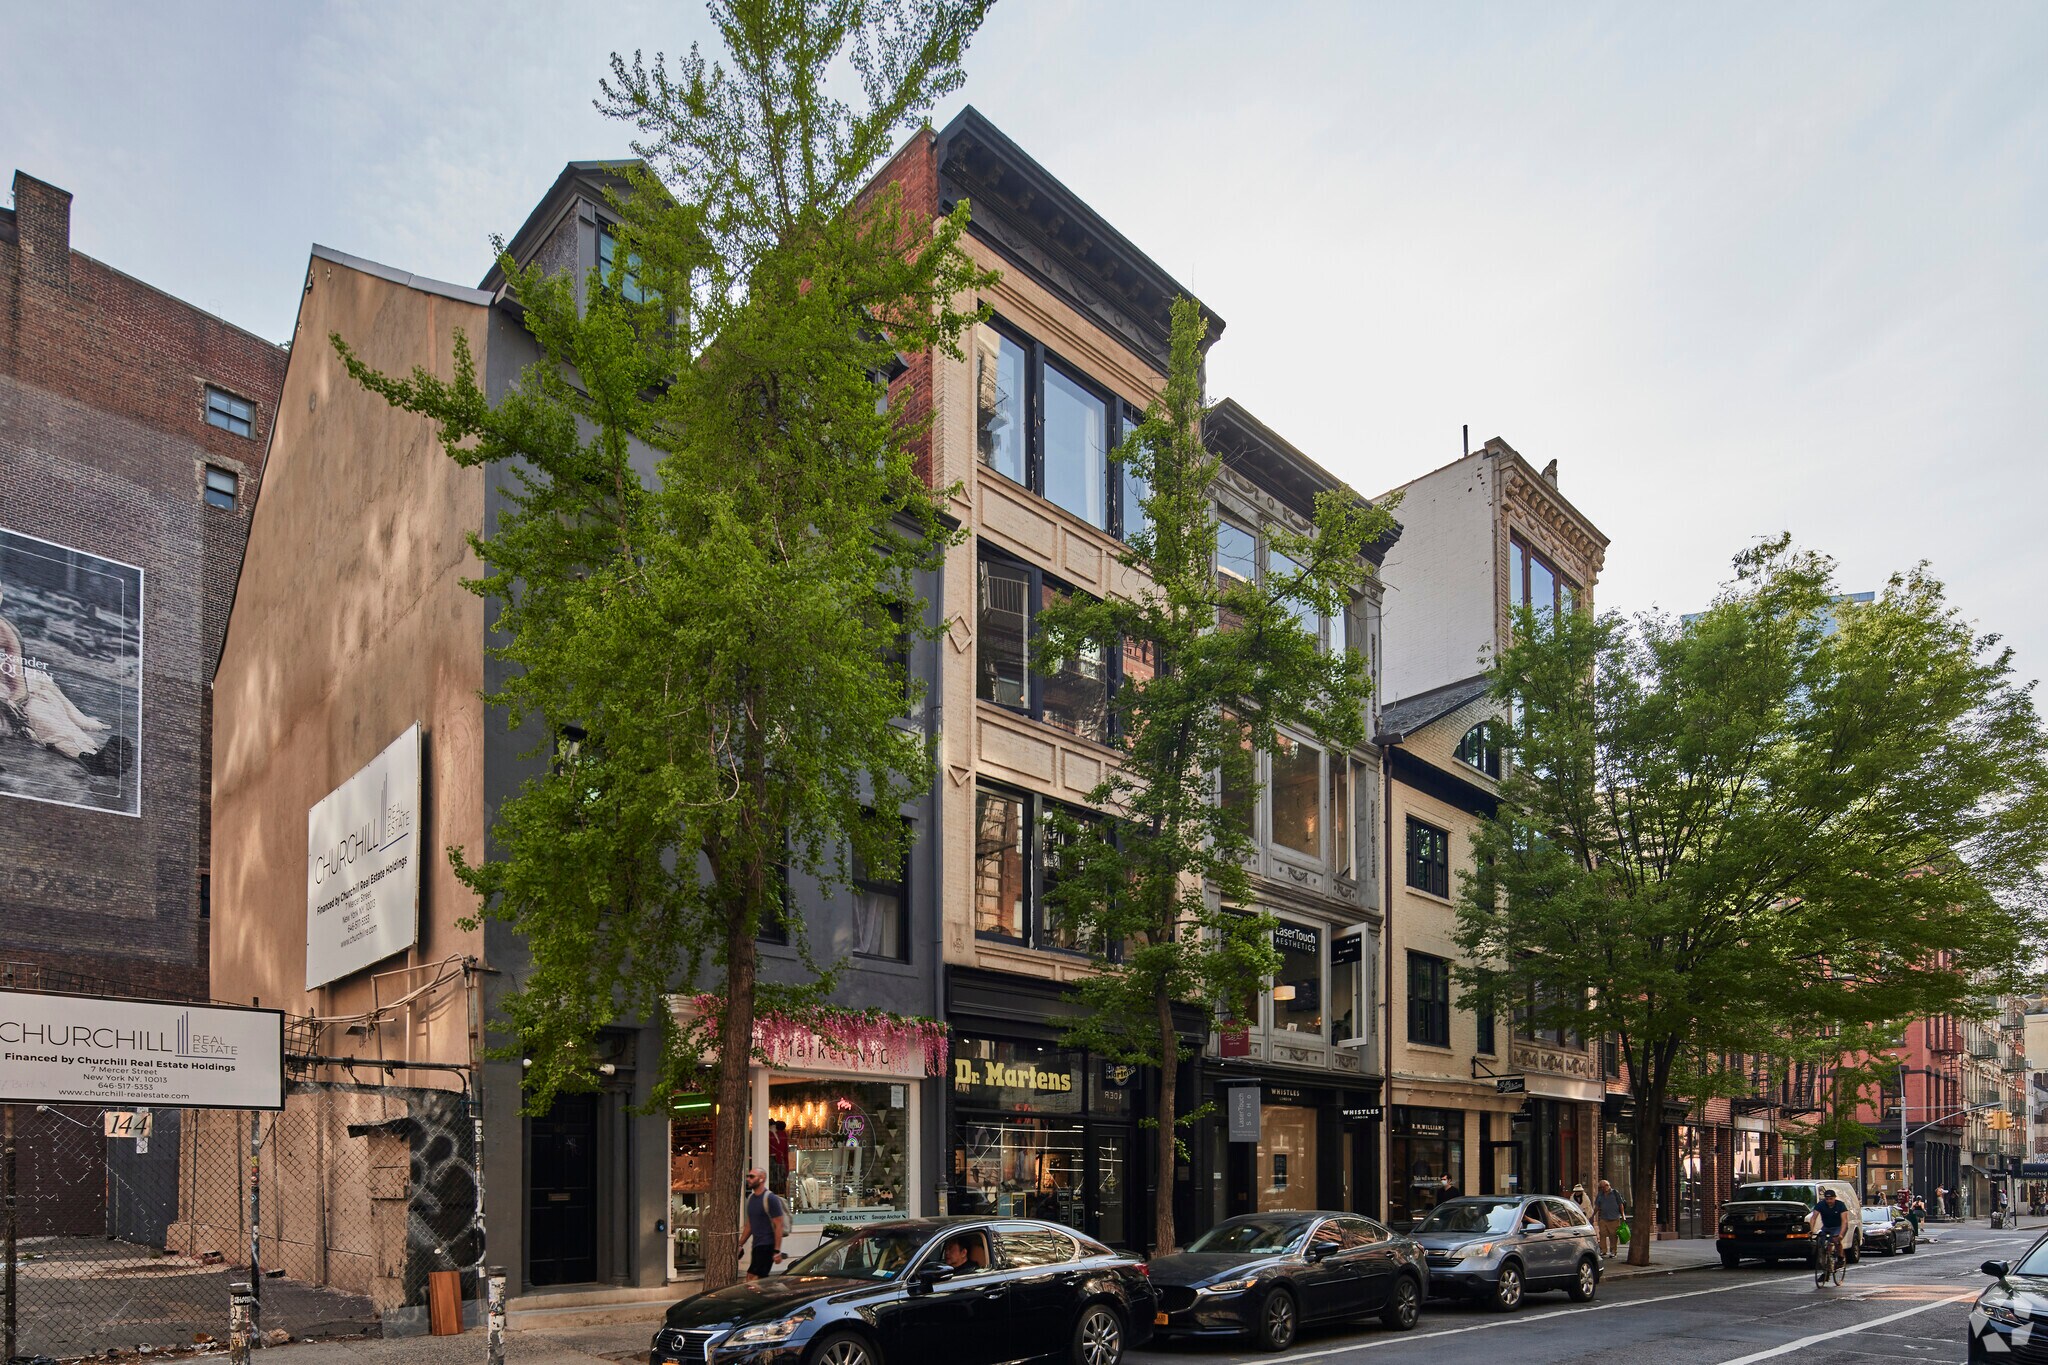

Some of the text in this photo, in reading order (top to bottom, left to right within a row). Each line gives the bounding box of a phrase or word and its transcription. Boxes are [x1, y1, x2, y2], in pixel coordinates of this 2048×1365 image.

[387, 801, 404, 820] REAL
[387, 811, 410, 838] ESTATE
[315, 818, 379, 885] CHURCHILL
[316, 896, 335, 916] Financed
[341, 881, 360, 902] Churchill
[360, 875, 370, 890] Real
[370, 868, 385, 885] Estate
[385, 856, 408, 876] Holdings
[1275, 937, 1316, 953] AESTHETICS
[0, 1021, 173, 1053] CHURCHILL
[192, 1034, 226, 1046] REAL
[192, 1043, 238, 1055] ESTATE
[4, 1052, 236, 1072] Financed by Churchill Real Estate Holdings
[91, 1065, 158, 1076] 7 Mercer Street
[955, 1059, 980, 1085] Dr.
[985, 1061, 1072, 1091] Martens
[83, 1073, 104, 1081] New
[105, 1074, 125, 1082] York
[144, 1076, 168, 1084] 10013
[97, 1082, 154, 1091] 646-517-5353
[1271, 1088, 1300, 1097] WHISTLES
[58, 1089, 190, 1100] www.churchill-realestate.com
[109, 1113, 151, 1135] 144
[830, 1214, 866, 1222] CANDLE.NYC
[871, 1213, 887, 1221] Savage
